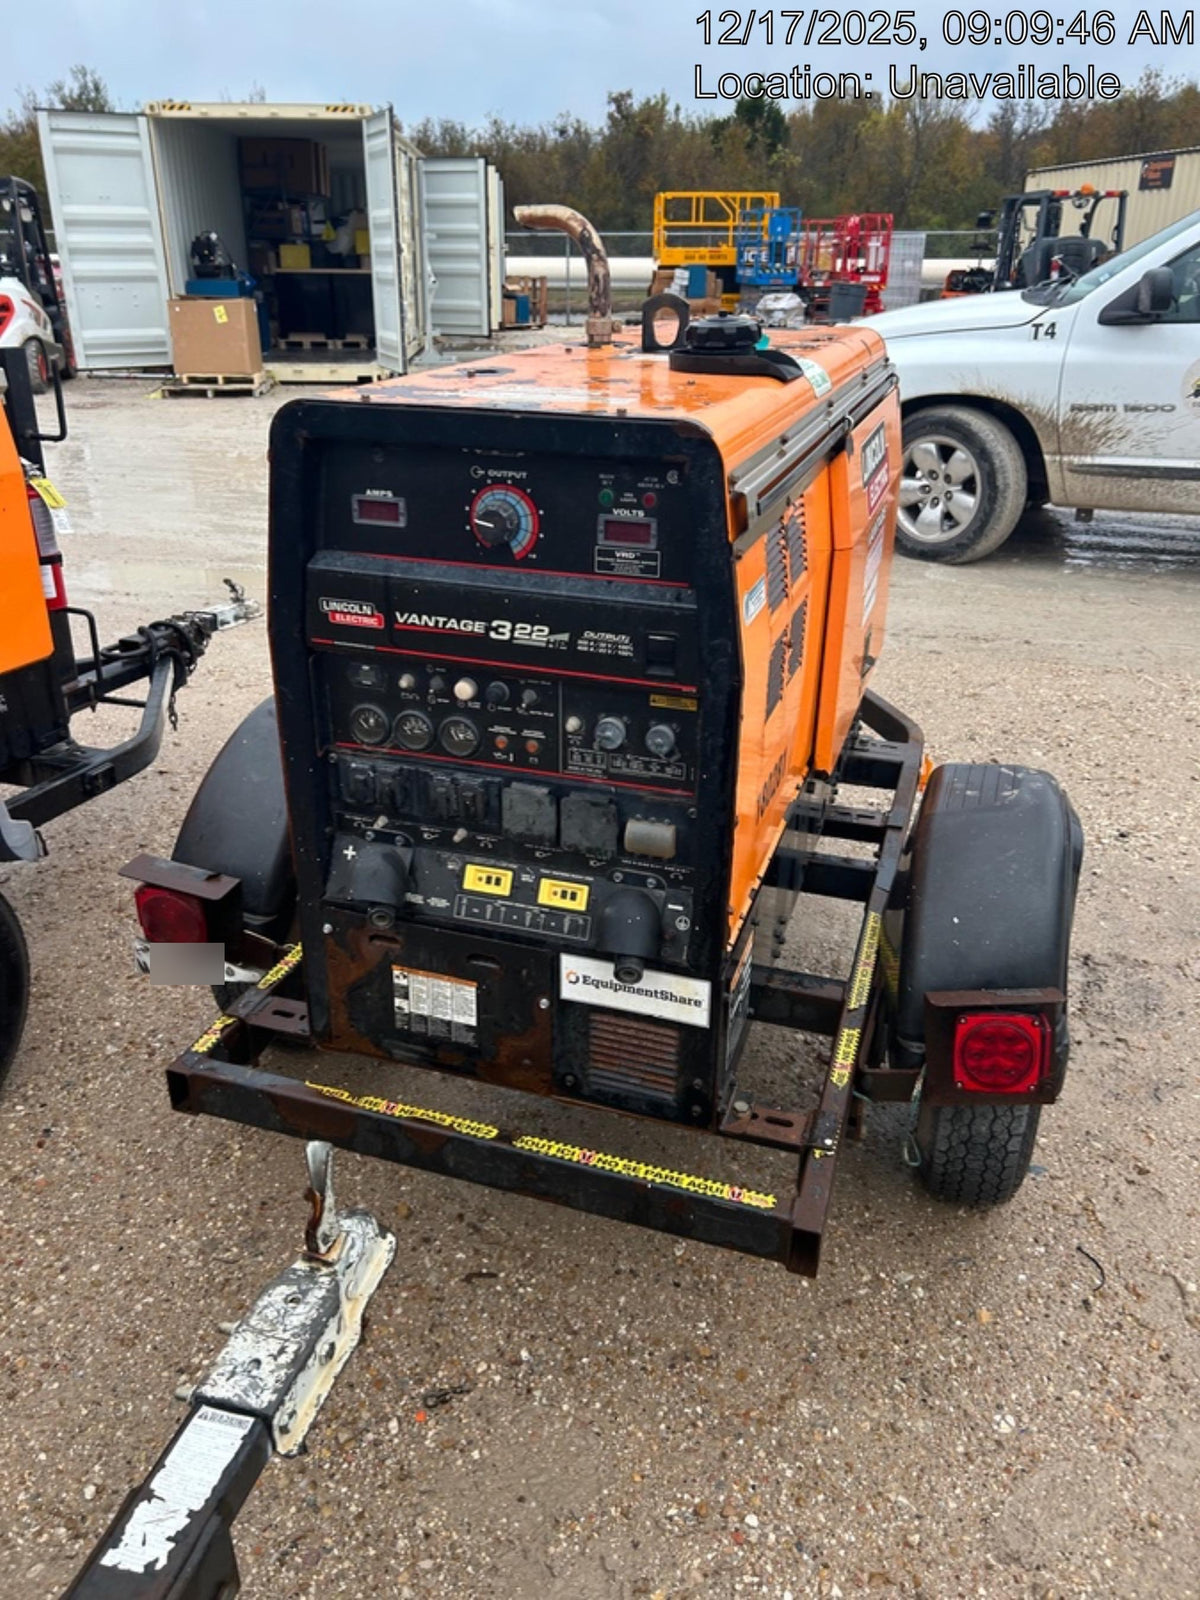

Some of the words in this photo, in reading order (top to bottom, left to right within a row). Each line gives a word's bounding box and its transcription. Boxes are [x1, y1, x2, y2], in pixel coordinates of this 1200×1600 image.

[1031, 322, 1057, 341] T4
[365, 489, 393, 498] AMPS
[613, 507, 645, 518] VOLTS
[322, 600, 373, 616] LINCOLN
[335, 612, 380, 627] ELECTRIC
[394, 611, 486, 634] VANTAGE
[489, 620, 550, 642] 322
[582, 974, 703, 1008] EquipmentShare
[596, 1154, 619, 1169] NO
[622, 1163, 641, 1174] SE
[645, 1168, 684, 1183] PARE
